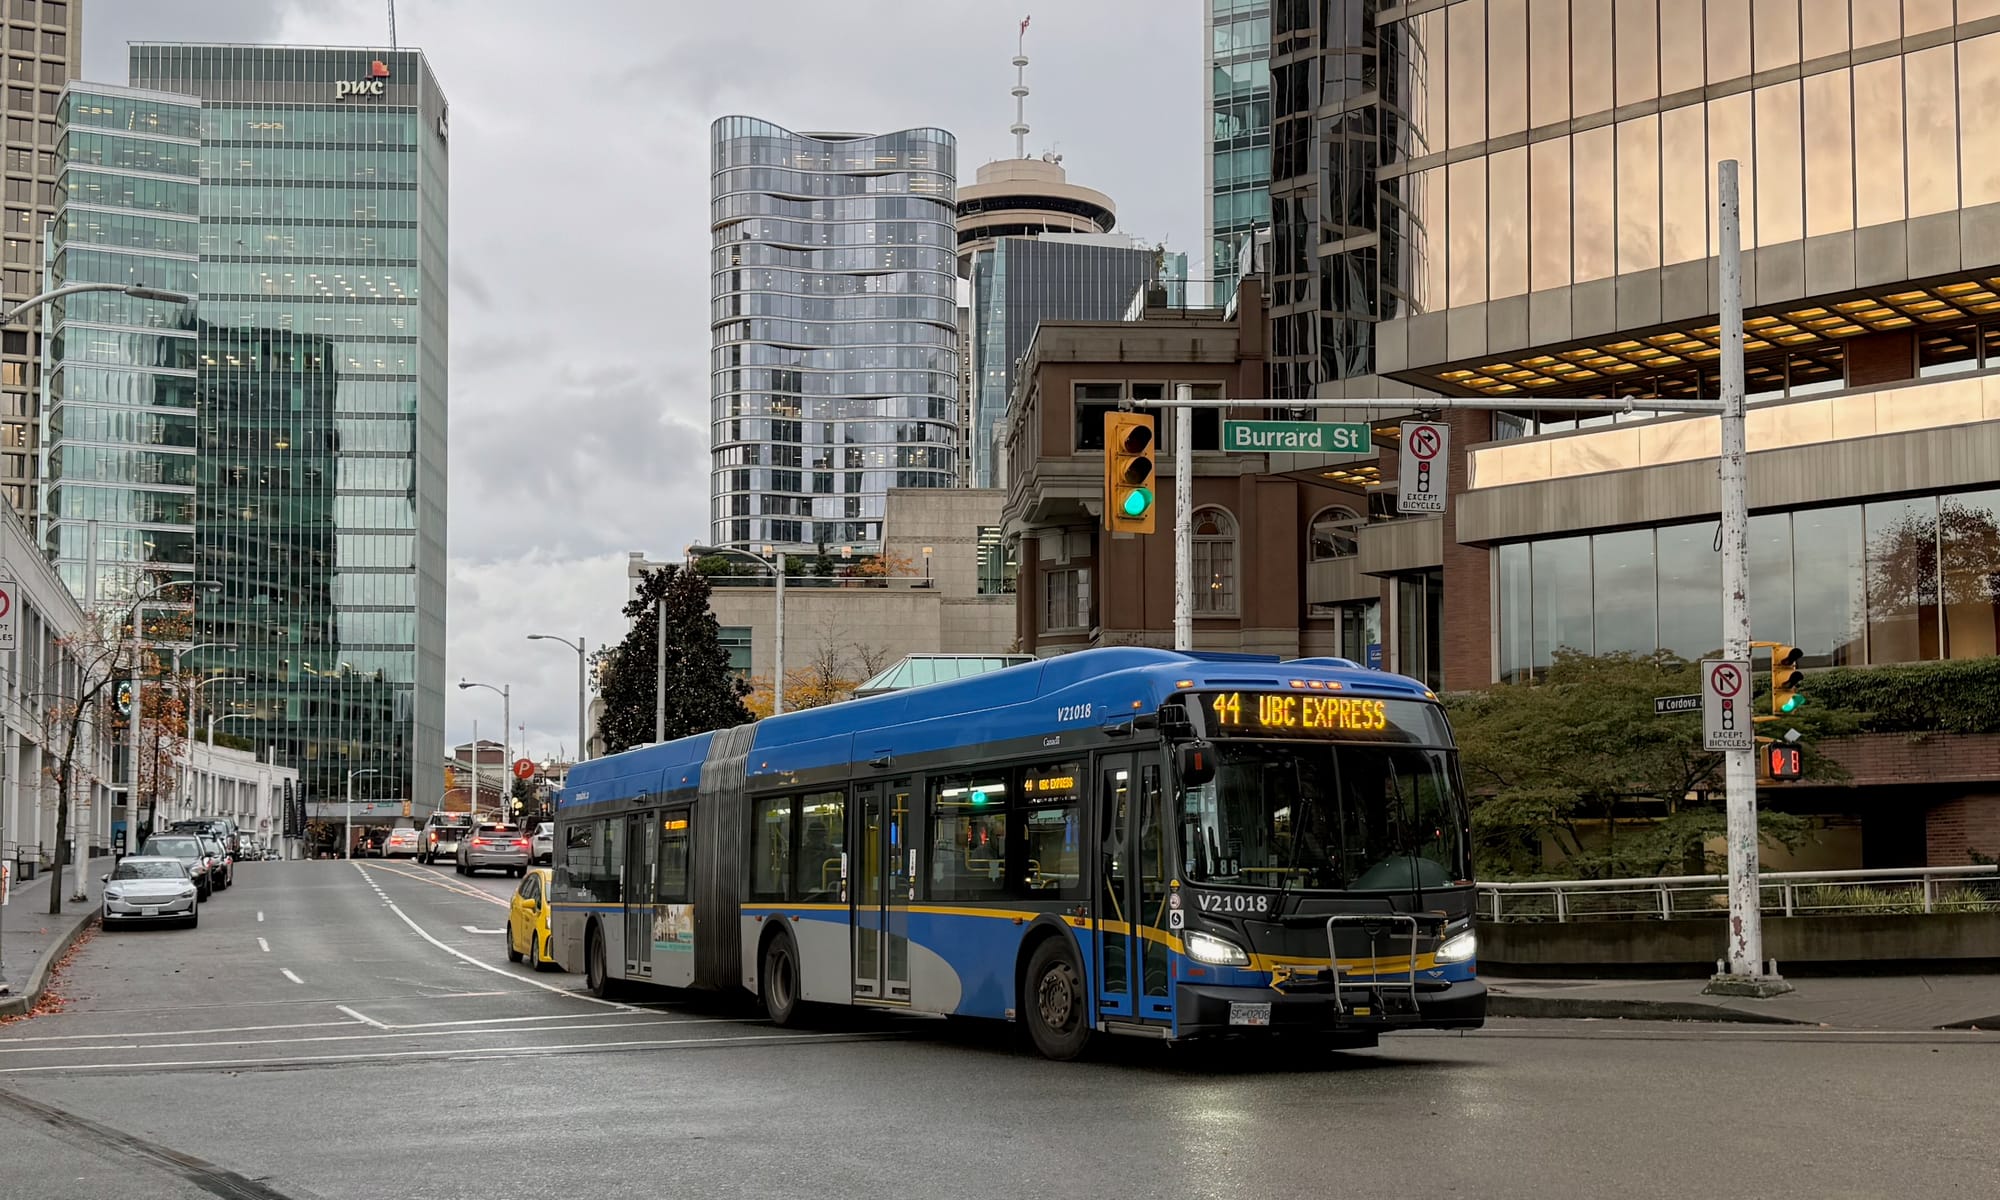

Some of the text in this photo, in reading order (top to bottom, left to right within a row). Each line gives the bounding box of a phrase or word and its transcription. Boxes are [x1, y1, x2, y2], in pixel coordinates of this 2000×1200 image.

[335, 80, 384, 99] pwc
[1235, 426, 1359, 448] Burrard St
[1407, 493, 1438, 501] EXCEPT
[1403, 501, 1441, 510] BICYCLES
[1657, 698, 1697, 710] W Cordova
[1058, 703, 1092, 722] V21018
[1212, 692, 1386, 729] 44 UBC EXPRESS
[1713, 731, 1743, 739] EXCEPT
[1709, 739, 1748, 747] BICYCLES
[1024, 779, 1033, 791] 44
[1198, 894, 1268, 912] V21018
